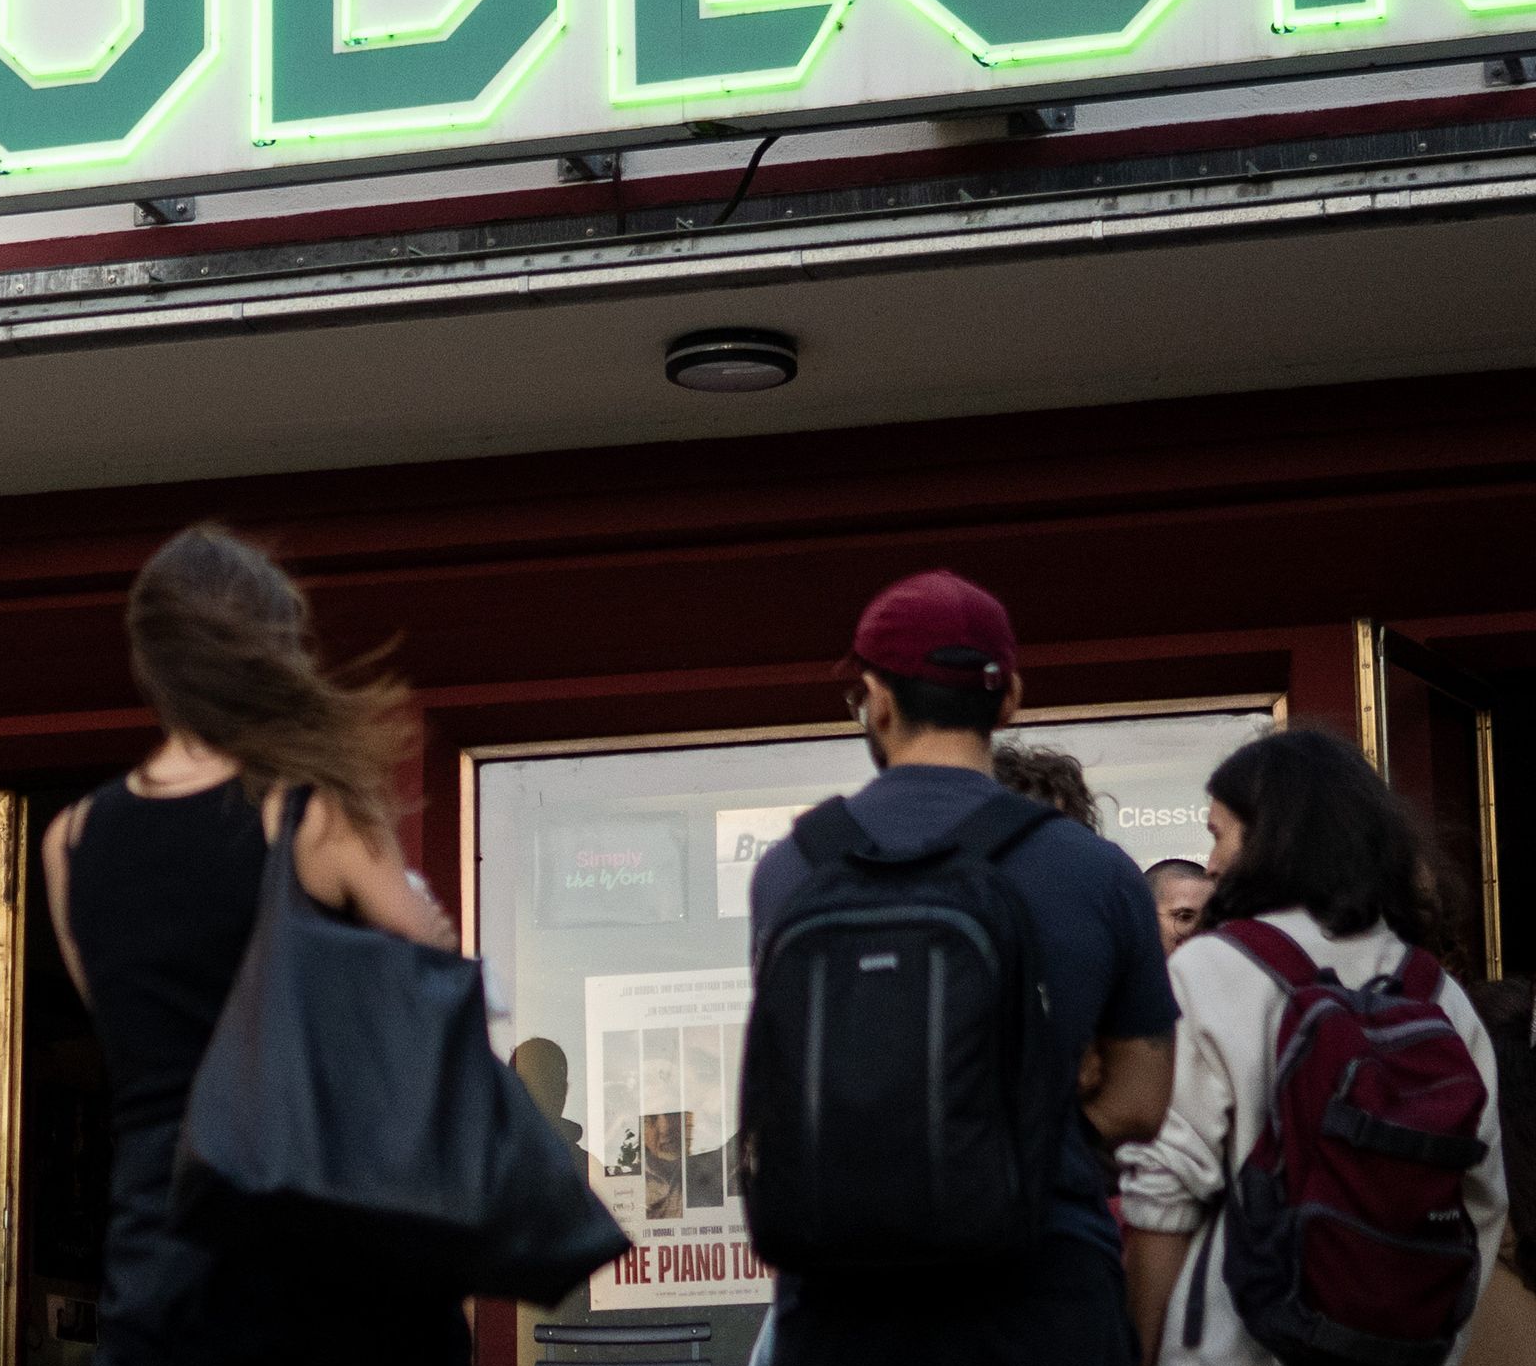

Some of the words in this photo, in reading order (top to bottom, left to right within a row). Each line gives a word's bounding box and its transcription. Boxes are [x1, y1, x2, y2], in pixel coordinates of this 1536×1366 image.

[1118, 804, 1210, 827] Classic
[575, 847, 644, 869] Simply
[733, 832, 778, 863] Br
[565, 869, 596, 890] the
[599, 866, 655, 891] Worst
[613, 1244, 651, 1286] THE
[658, 1242, 726, 1283] PIANO
